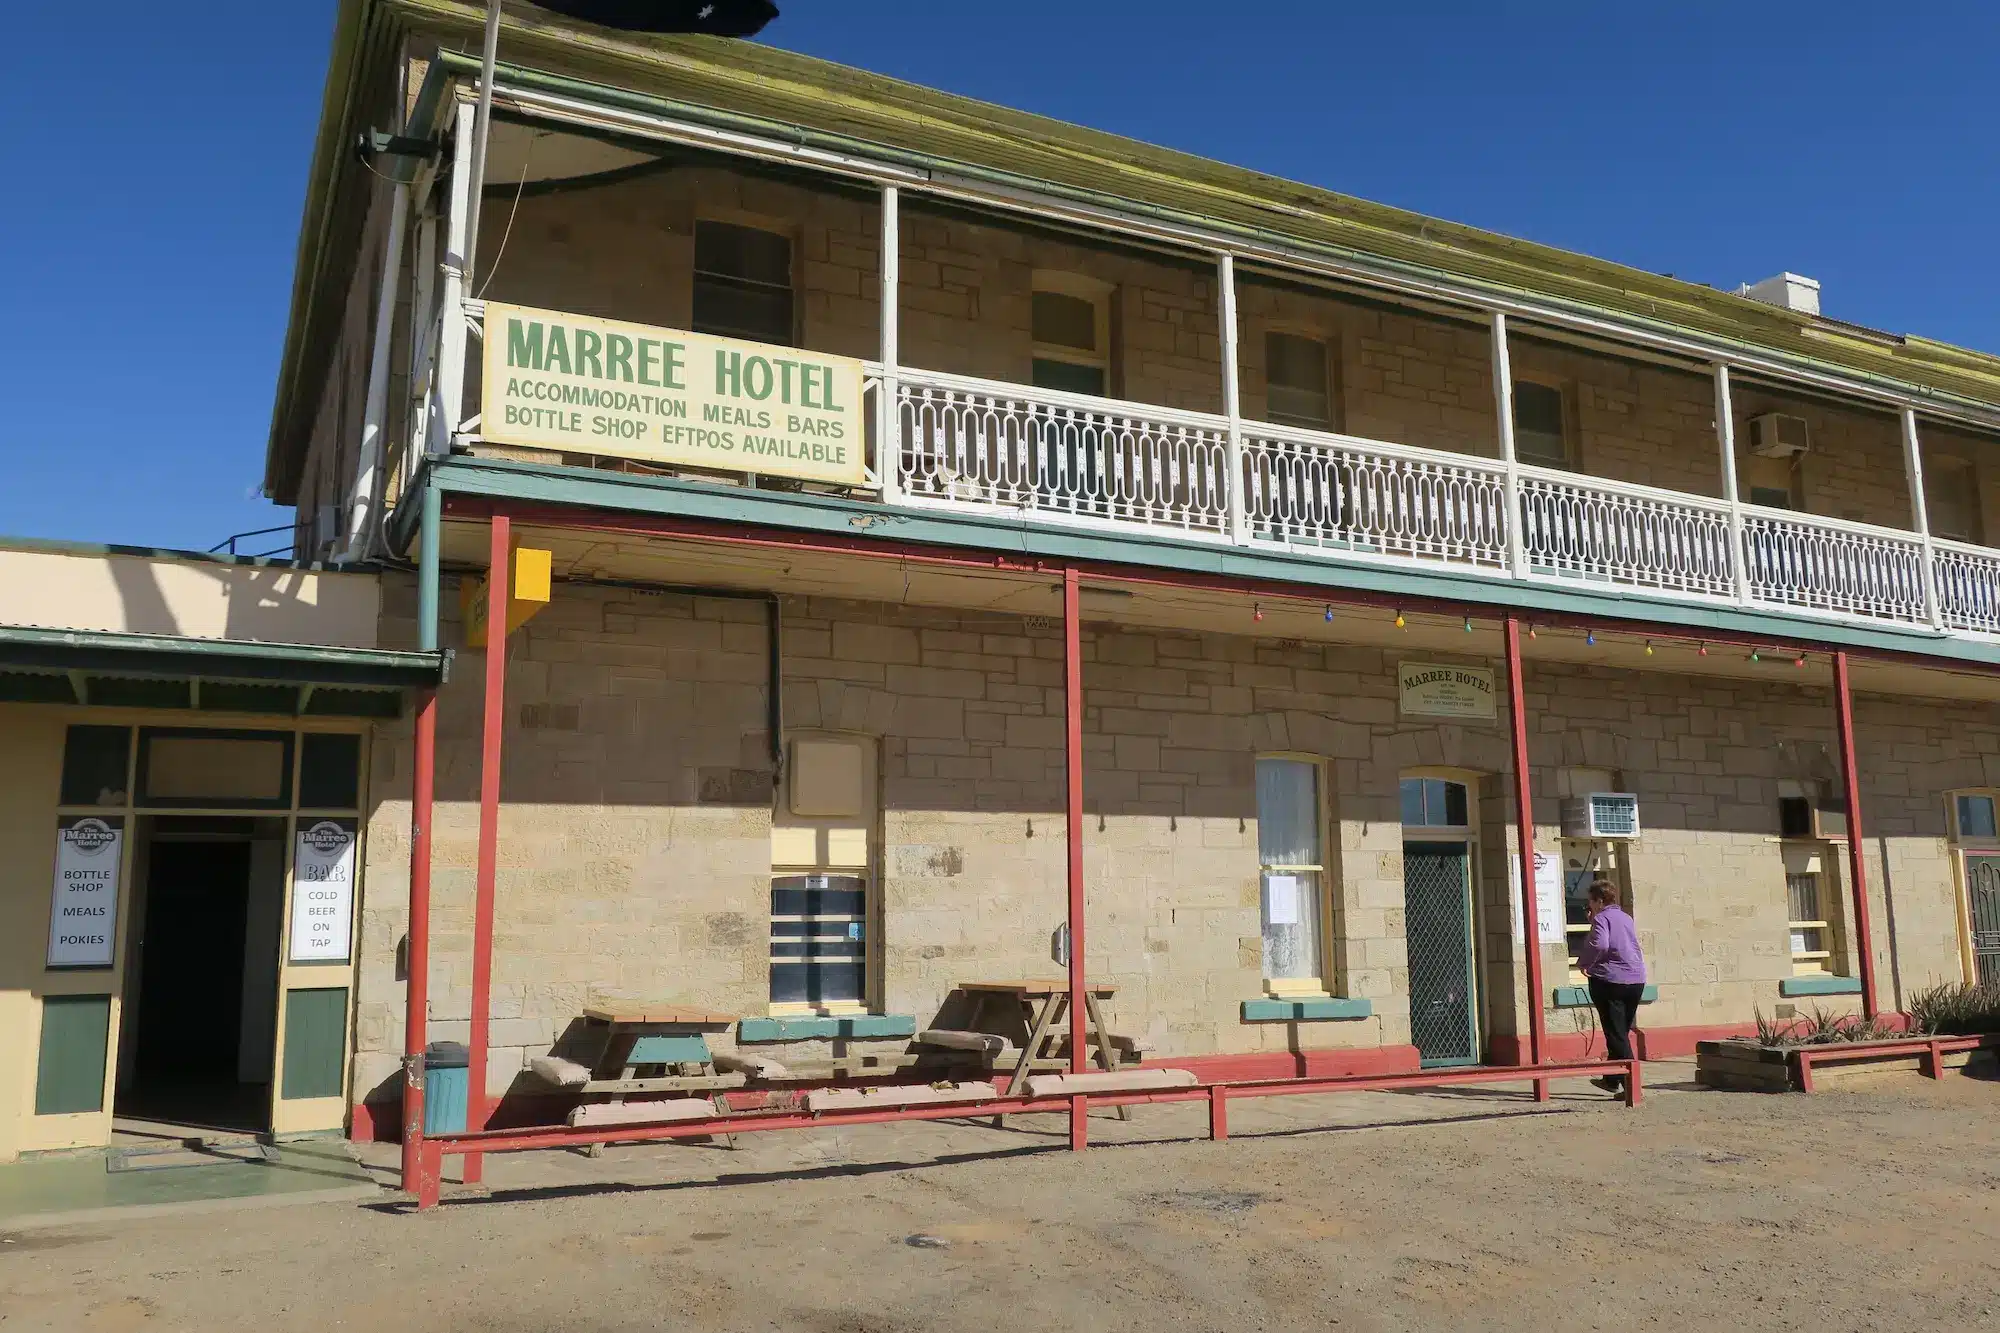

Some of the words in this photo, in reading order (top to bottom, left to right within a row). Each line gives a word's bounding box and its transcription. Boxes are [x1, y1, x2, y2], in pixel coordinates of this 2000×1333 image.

[506, 318, 686, 390] MARREE
[715, 349, 845, 413] HOTEL
[506, 377, 687, 419] ACCOMMODATION
[703, 403, 771, 430] MEALS
[787, 414, 844, 439] BARS
[505, 404, 582, 434] BOTTLE
[591, 414, 648, 440] SHOP
[662, 424, 735, 451] EFTPOS
[742, 435, 846, 465] AVAILABLE
[1403, 670, 1453, 690] MARREE
[1455, 671, 1492, 694] HOTEL
[65, 830, 114, 840] Marree
[304, 833, 347, 842] Marree
[64, 870, 111, 880] BOTTLE
[303, 864, 346, 882] BAR
[68, 883, 104, 892] SHOP
[308, 891, 338, 900] COLD
[63, 907, 106, 916] MEALS
[308, 907, 336, 916] BEER
[312, 922, 330, 932] ON
[60, 935, 105, 945] POKIES
[310, 938, 331, 947] TAP
